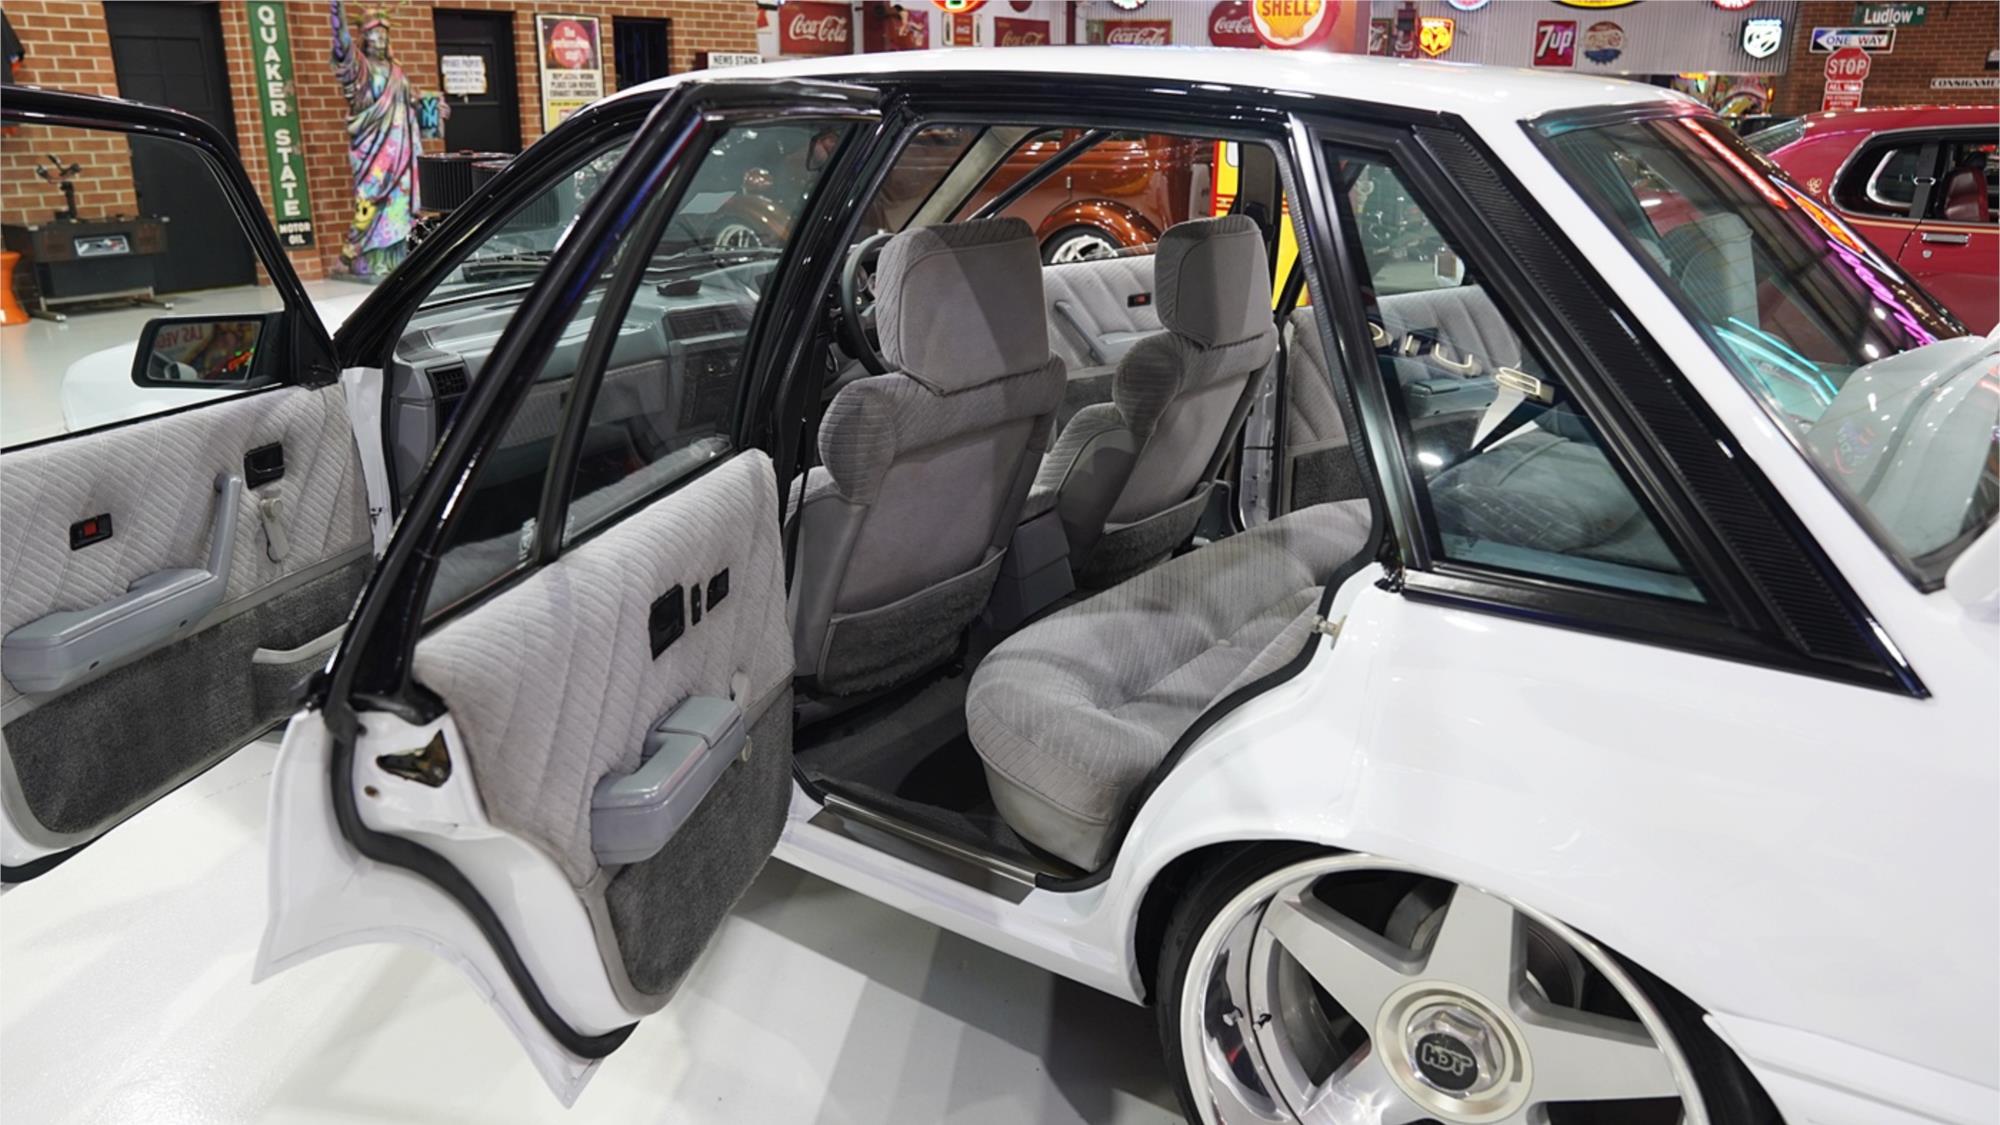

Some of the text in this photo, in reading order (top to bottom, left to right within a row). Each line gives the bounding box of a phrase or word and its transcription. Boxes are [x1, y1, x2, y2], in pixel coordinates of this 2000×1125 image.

[1262, 0, 1312, 16] SHELL
[1863, 8, 1913, 24] Ludlow
[789, 13, 848, 42] Coca-Cola
[1536, 25, 1574, 58] 7up
[1826, 36, 1885, 46] ONE WAY
[713, 55, 758, 65] NEWS STAND
[1828, 58, 1867, 76] STOP
[257, 5, 301, 217] QUAKER STATE
[279, 222, 311, 234] MOTOR
[288, 234, 306, 246] OIL
